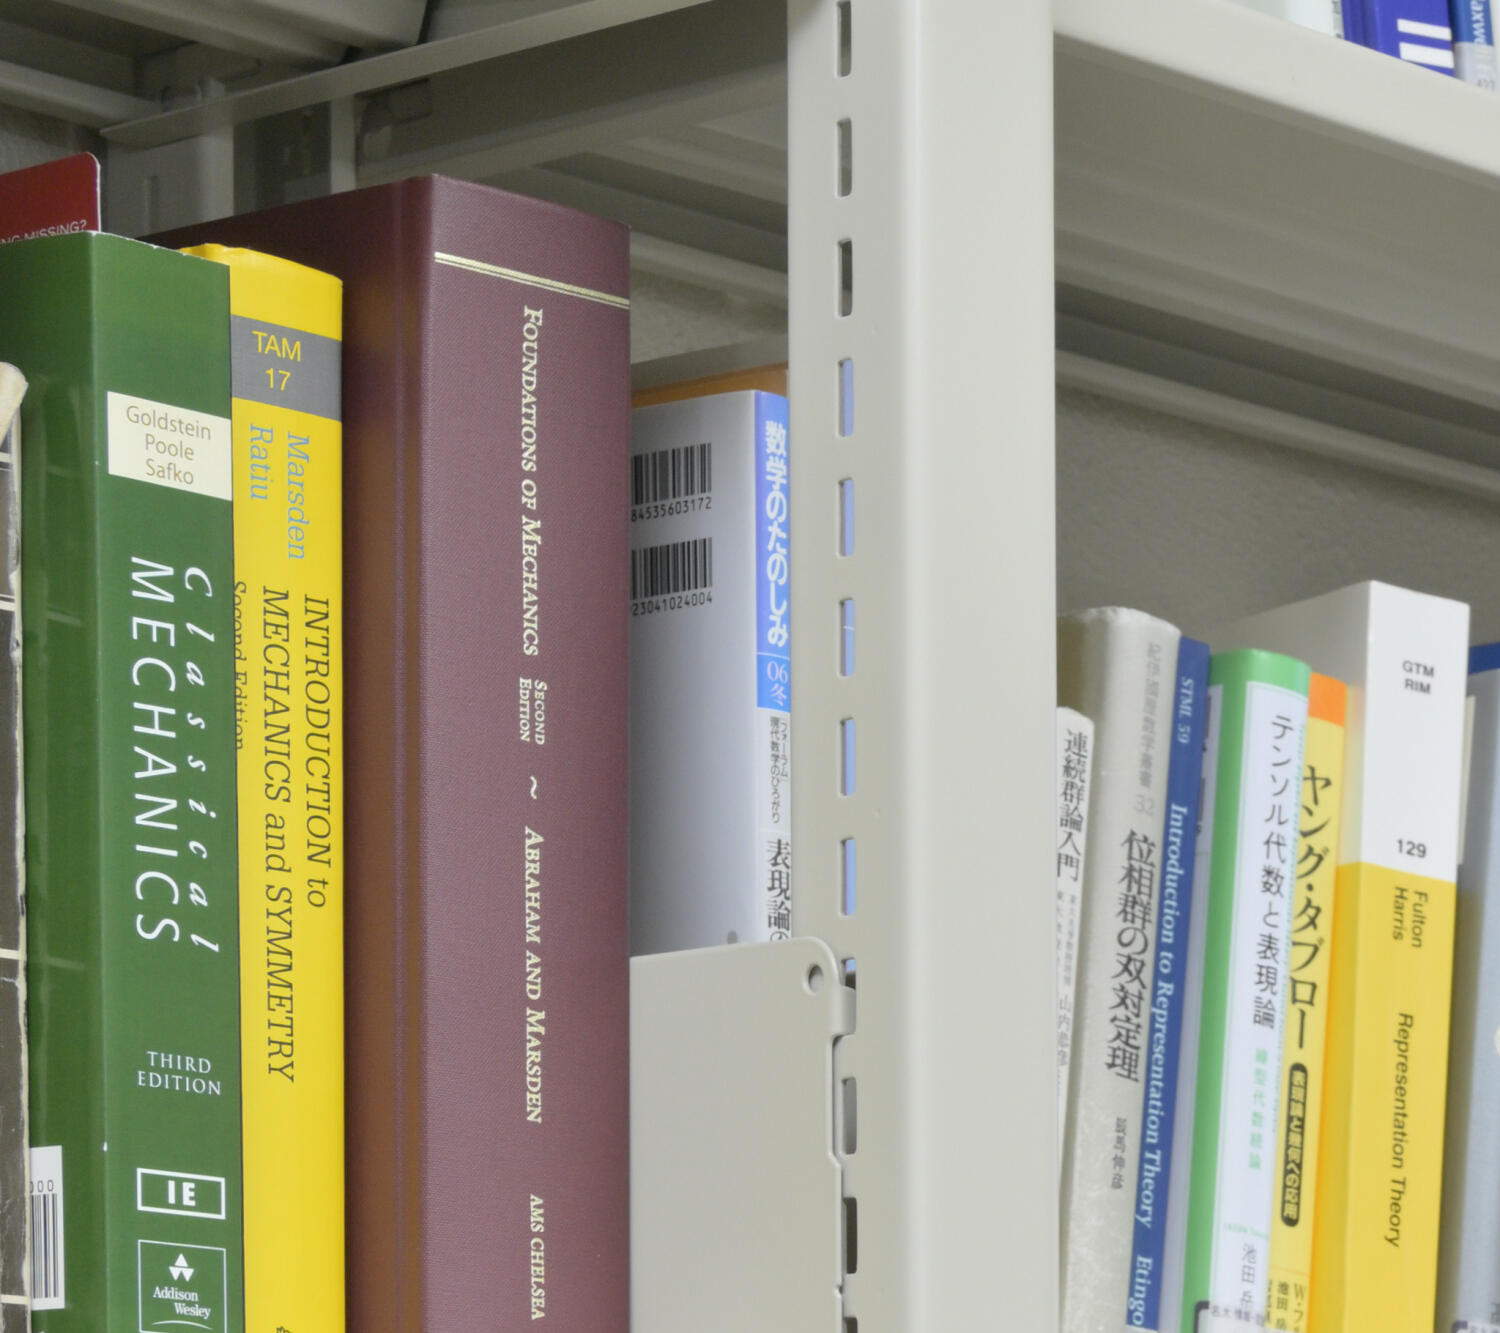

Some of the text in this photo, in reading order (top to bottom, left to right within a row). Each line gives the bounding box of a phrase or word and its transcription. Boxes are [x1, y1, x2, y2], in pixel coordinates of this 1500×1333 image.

[251, 330, 302, 363] TAM
[264, 368, 292, 391] 17
[125, 404, 212, 441] Goldstein
[144, 433, 195, 463] Poole
[145, 459, 194, 485] Safko
[248, 422, 274, 501] Ratiu
[522, 306, 543, 656] FOUNDATIONS OF MECHANICS
[286, 430, 310, 561] Marsden
[765, 420, 789, 648] 数学のたのしみ
[1402, 660, 1435, 678] GTM
[1404, 678, 1431, 695] RIM
[519, 677, 532, 742] EDITION
[534, 679, 547, 745] SECOND
[129, 556, 179, 946] MECHANICS
[183, 565, 221, 953] Classical
[305, 594, 331, 907] INTRODUCTION to
[264, 585, 295, 1083] MECHANICS and SYMMETRY
[1396, 838, 1427, 859] 129
[1252, 715, 1295, 1031] テンソル代数と表現論
[1288, 765, 1332, 1050] ヤング・タブロー
[1392, 886, 1409, 941] Harris
[1411, 890, 1429, 949] Fulton
[525, 826, 546, 1124] ABRAHAM AND MARSDEN
[1105, 829, 1157, 1083] 位相群の双対定理
[1135, 802, 1188, 1229] Introduction to Representation Theory
[137, 1071, 221, 1096] EDITION
[147, 1051, 210, 1074] THIRD
[1384, 1012, 1414, 1249] Representation Theory
[167, 1180, 196, 1207] IE
[529, 1194, 546, 1320] AMS CHELSEA
[152, 1285, 199, 1302] Addison
[173, 1302, 212, 1320] Wesley
